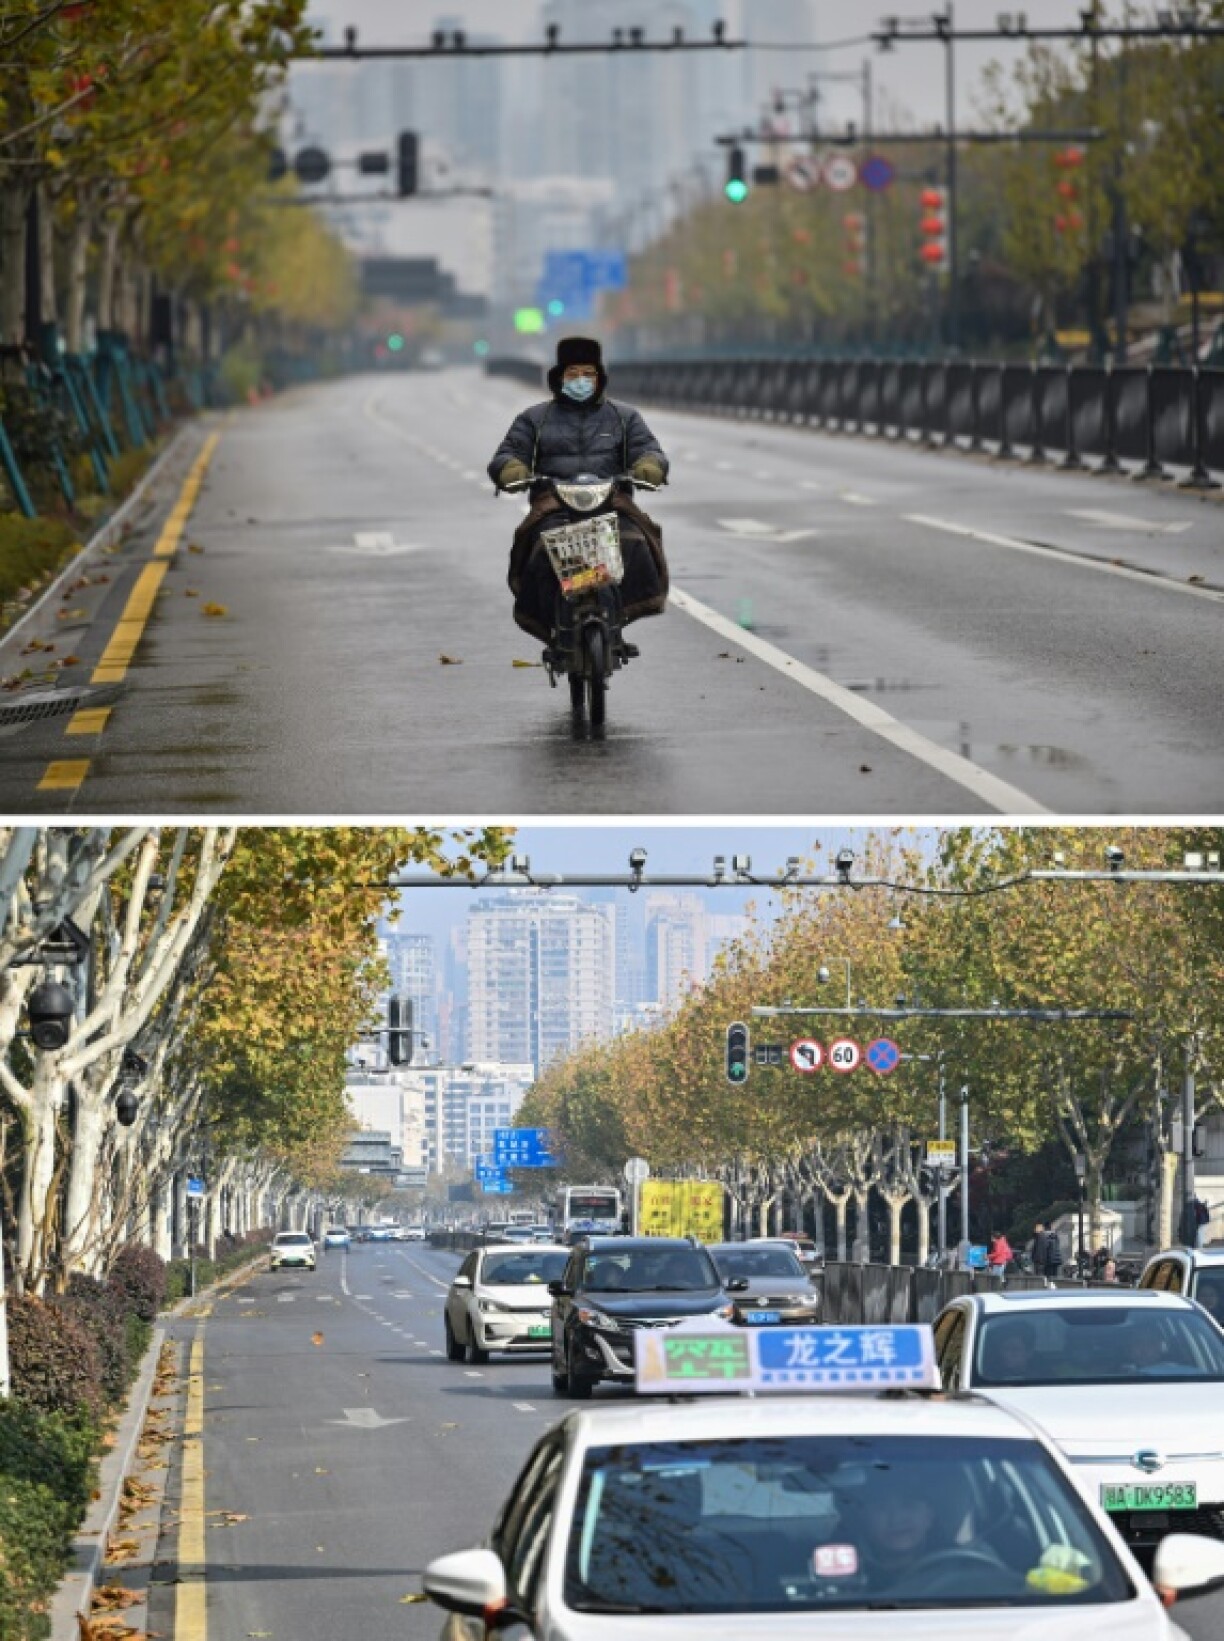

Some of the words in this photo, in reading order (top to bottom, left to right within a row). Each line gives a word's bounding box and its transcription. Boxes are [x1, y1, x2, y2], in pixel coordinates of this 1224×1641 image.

[832, 1046, 854, 1063] 60
[784, 1331, 897, 1366] 龙之辉
